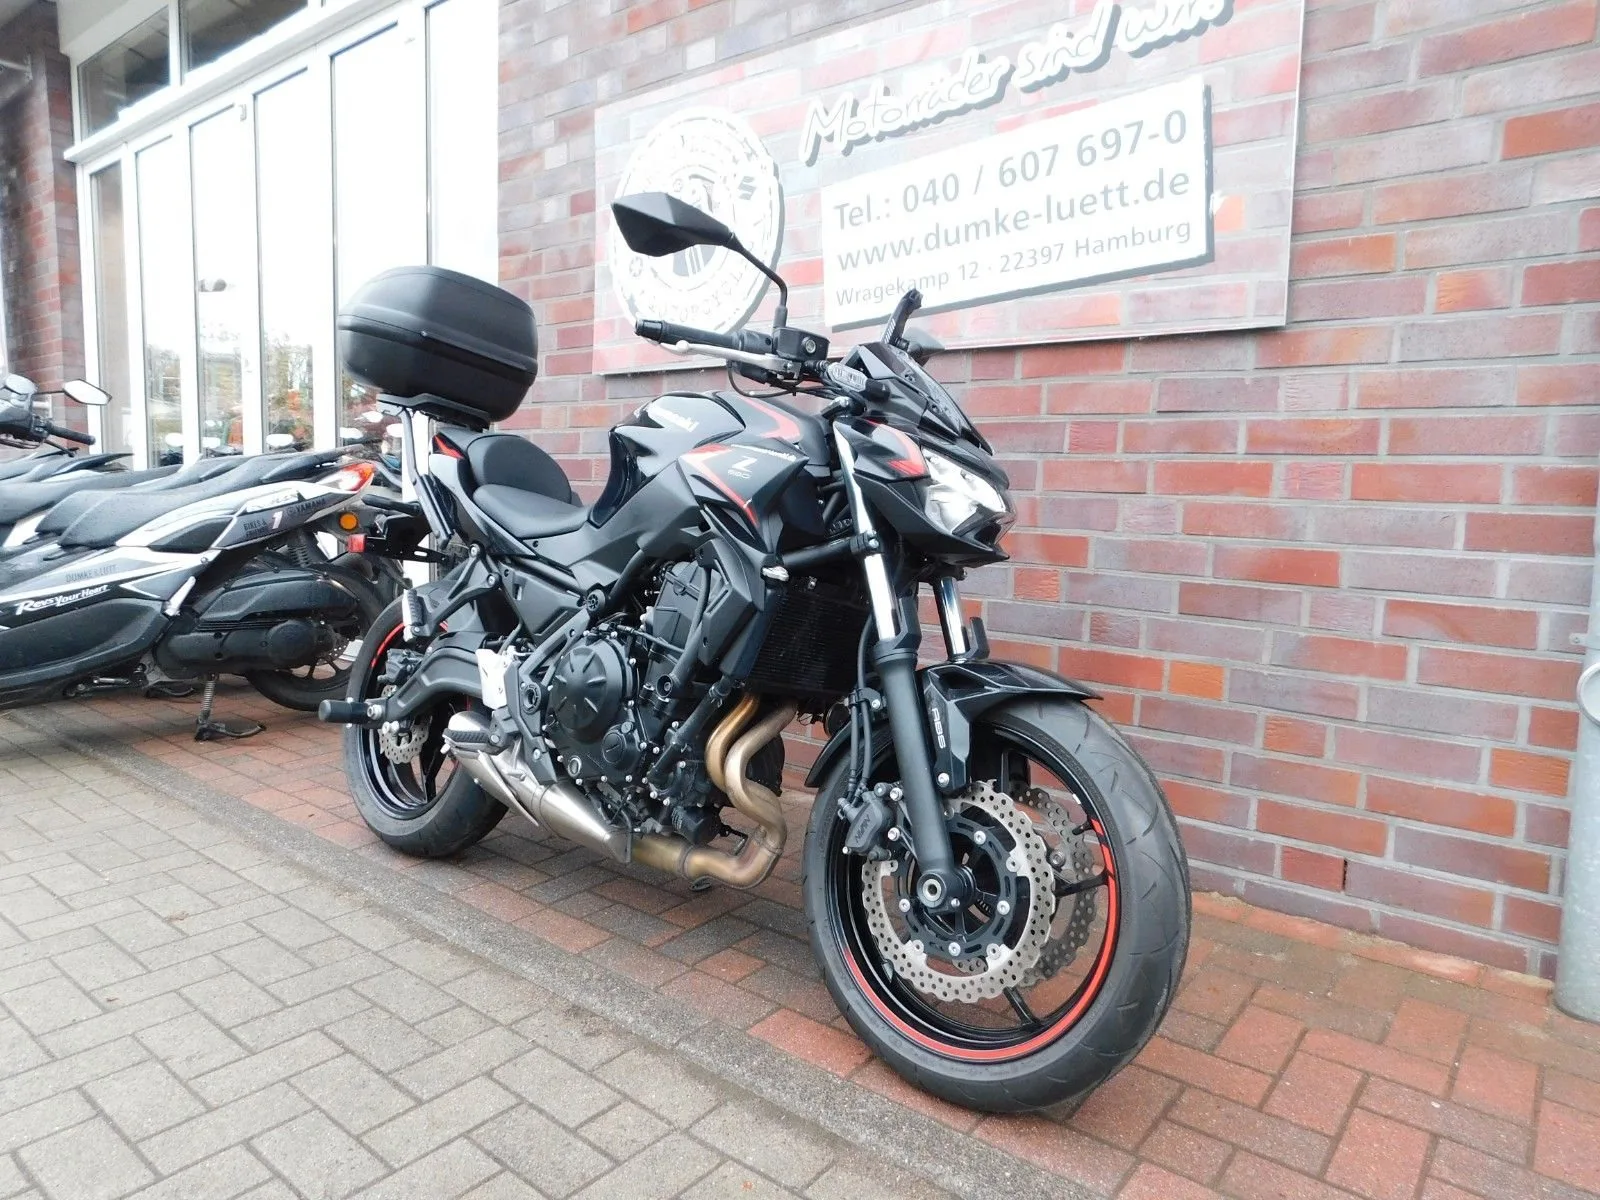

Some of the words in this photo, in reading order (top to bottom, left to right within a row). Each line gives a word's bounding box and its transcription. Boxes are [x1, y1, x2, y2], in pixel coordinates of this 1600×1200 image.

[1016, 2, 1108, 84] sind
[834, 196, 891, 230] Tel.:
[903, 173, 960, 213] 040
[973, 164, 984, 195] /
[998, 144, 1059, 188] 607
[1076, 109, 1187, 167] 697-0
[838, 167, 1190, 272] www.dumke-luett.de
[835, 270, 949, 307] Wragekamp
[958, 261, 979, 282] 12
[1000, 243, 1064, 274] 22397
[1075, 219, 1191, 259] Hamburg
[731, 455, 758, 473] Z
[14, 598, 54, 616] Revs
[54, 591, 82, 608] Your
[81, 584, 110, 598] Heart
[931, 707, 947, 750] ABS
